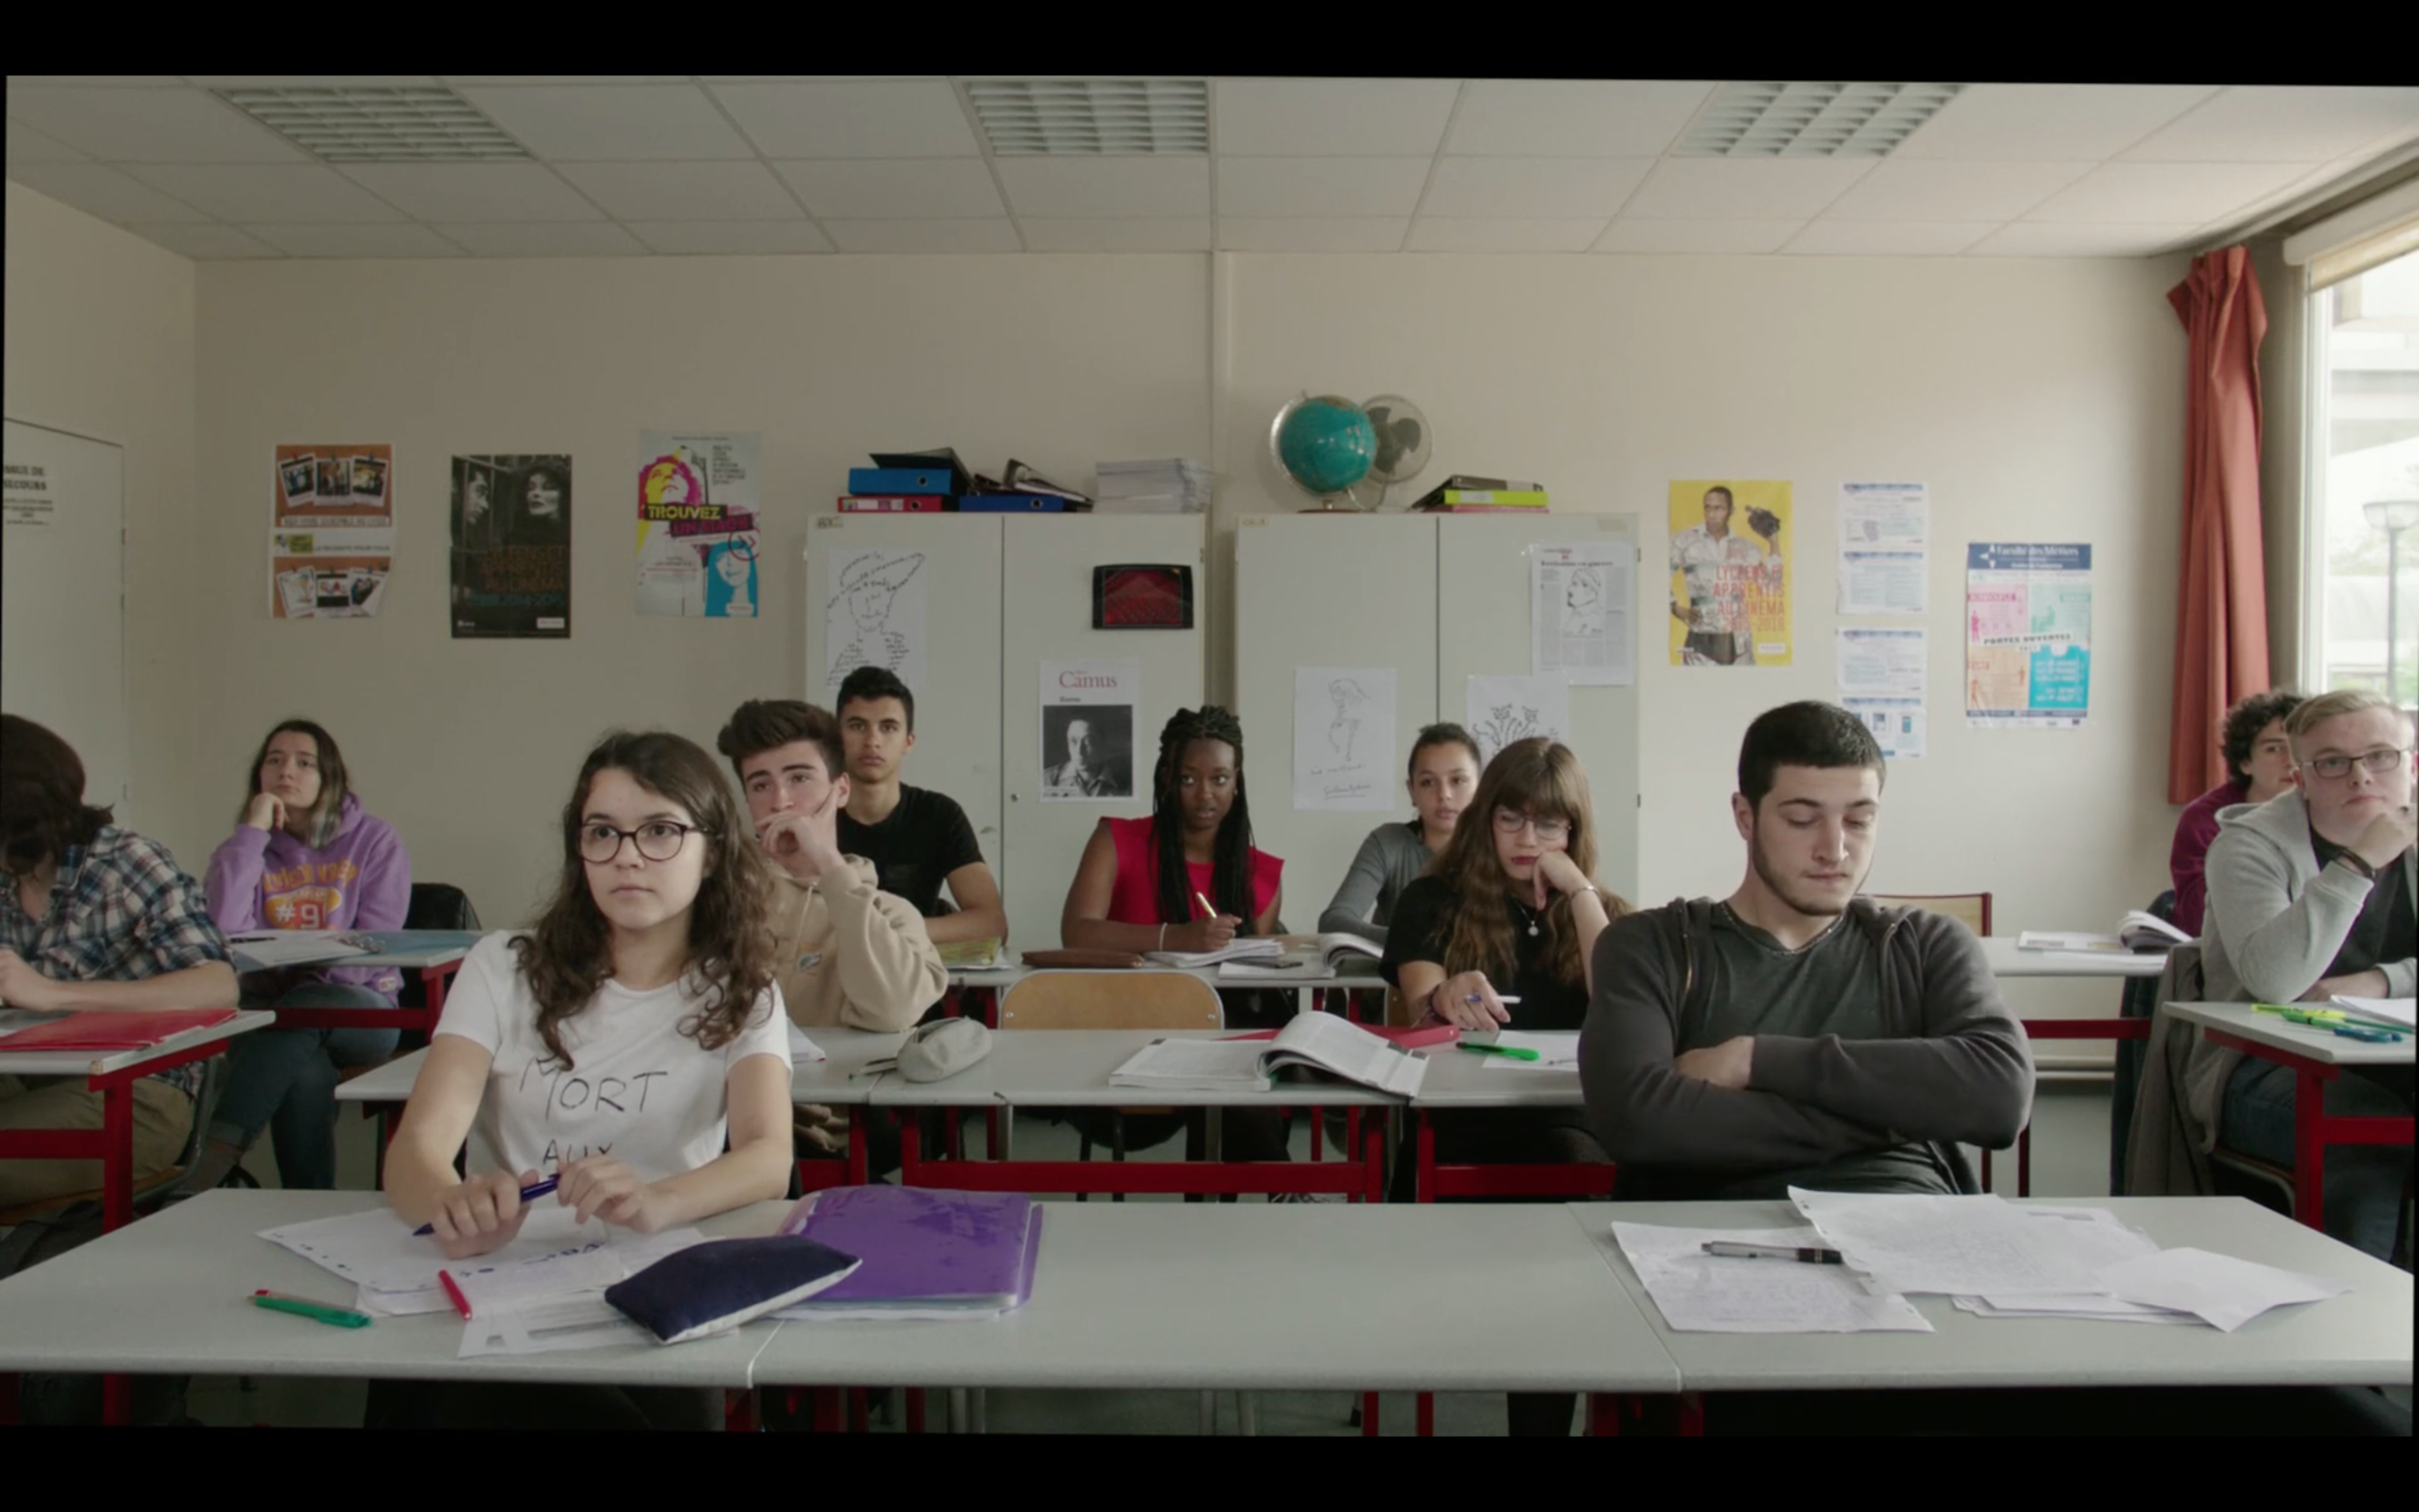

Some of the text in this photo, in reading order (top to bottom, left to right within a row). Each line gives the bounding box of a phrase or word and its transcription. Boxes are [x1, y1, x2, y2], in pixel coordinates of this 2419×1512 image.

[647, 505, 721, 520] TROUVEZ
[1997, 546, 2079, 556] Faculté des Métiers
[1713, 582, 1785, 598] APPRENTIS
[1717, 601, 1735, 615] AU
[1984, 633, 2072, 645] PORTES OUVERTES
[1059, 670, 1118, 689] Camus
[519, 1055, 669, 1120] MORT
